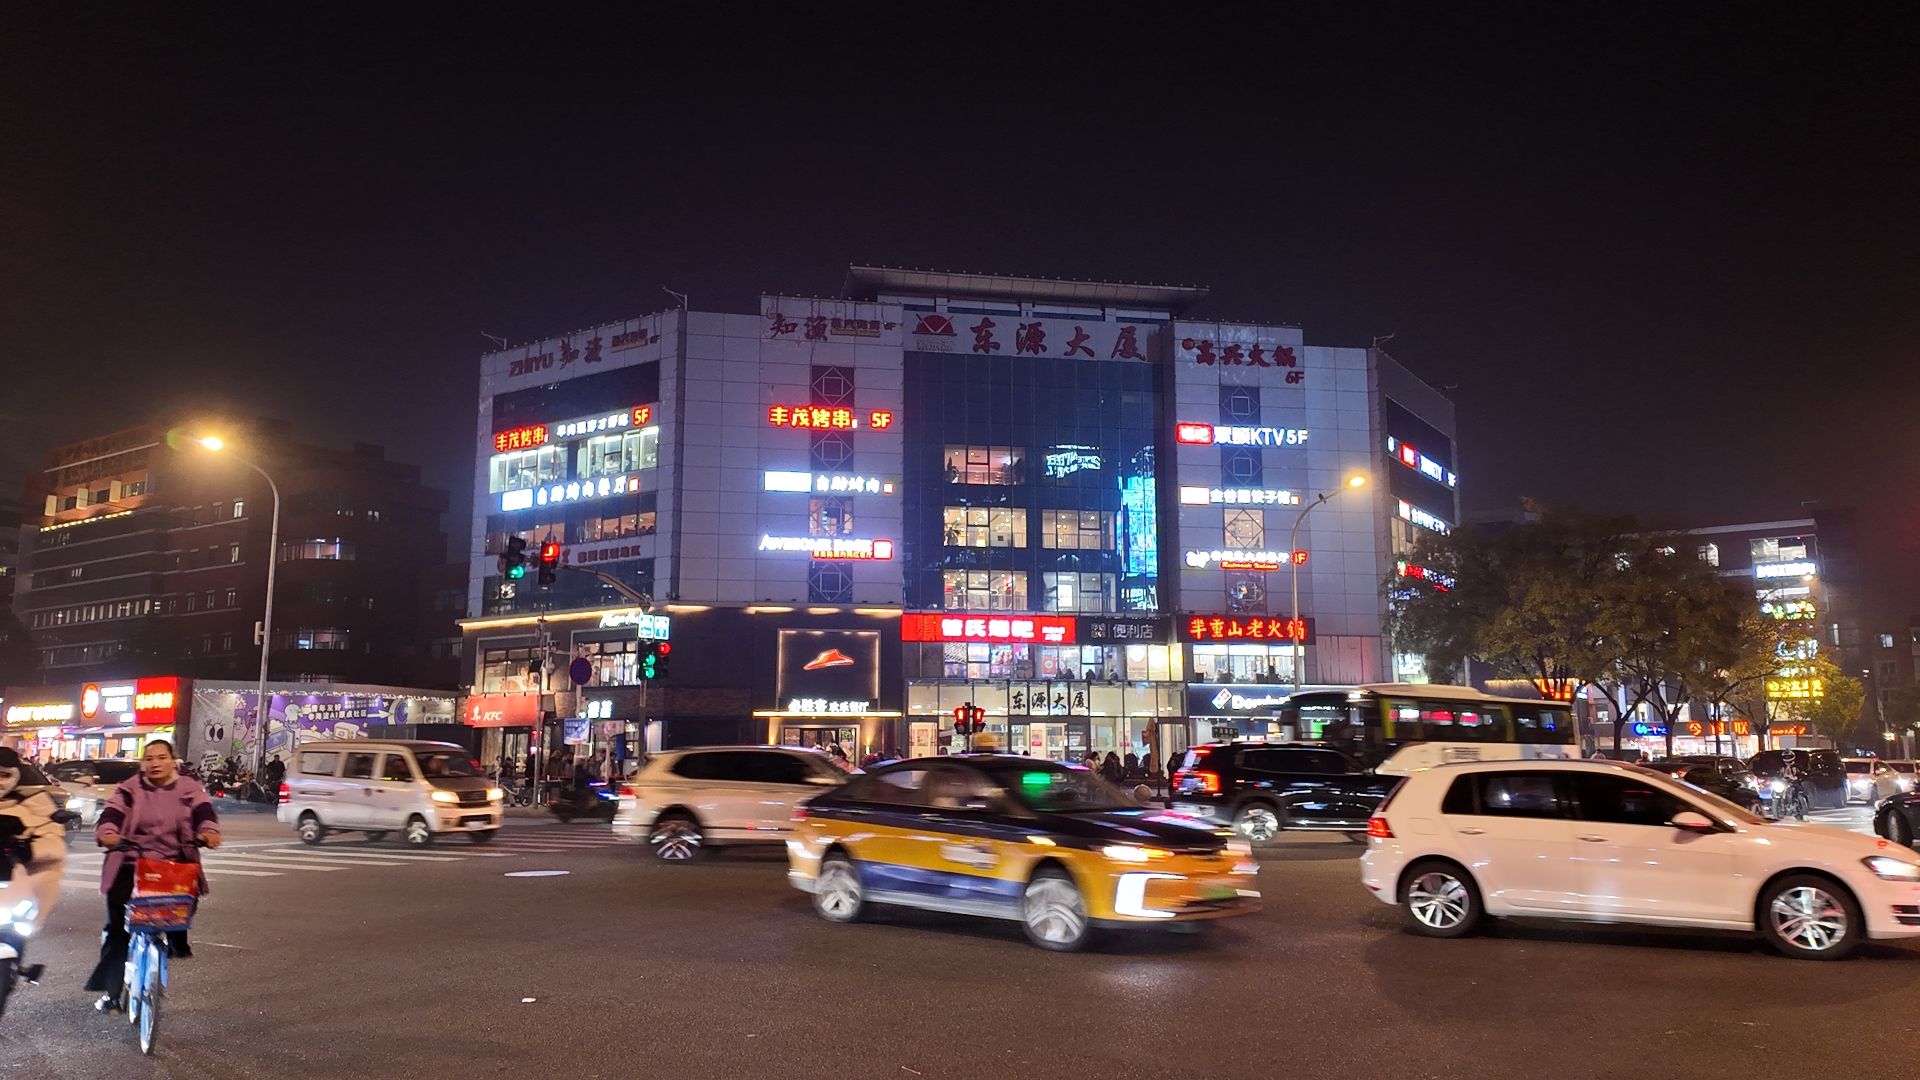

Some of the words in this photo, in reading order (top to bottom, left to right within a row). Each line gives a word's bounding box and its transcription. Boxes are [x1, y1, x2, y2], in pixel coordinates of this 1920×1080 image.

[970, 316, 1146, 361] 东源大厦
[509, 353, 554, 377] ZHIYU
[1285, 371, 1304, 384] 6F
[770, 406, 851, 428] 丰茂烤串
[871, 412, 890, 428] 5F
[495, 425, 545, 452] 丰茂烤串
[634, 407, 650, 425] 5F
[1286, 430, 1308, 445] 5F
[1112, 623, 1153, 640] 便利店
[1012, 691, 1089, 711] 东源大厦
[482, 711, 503, 721] KFC
